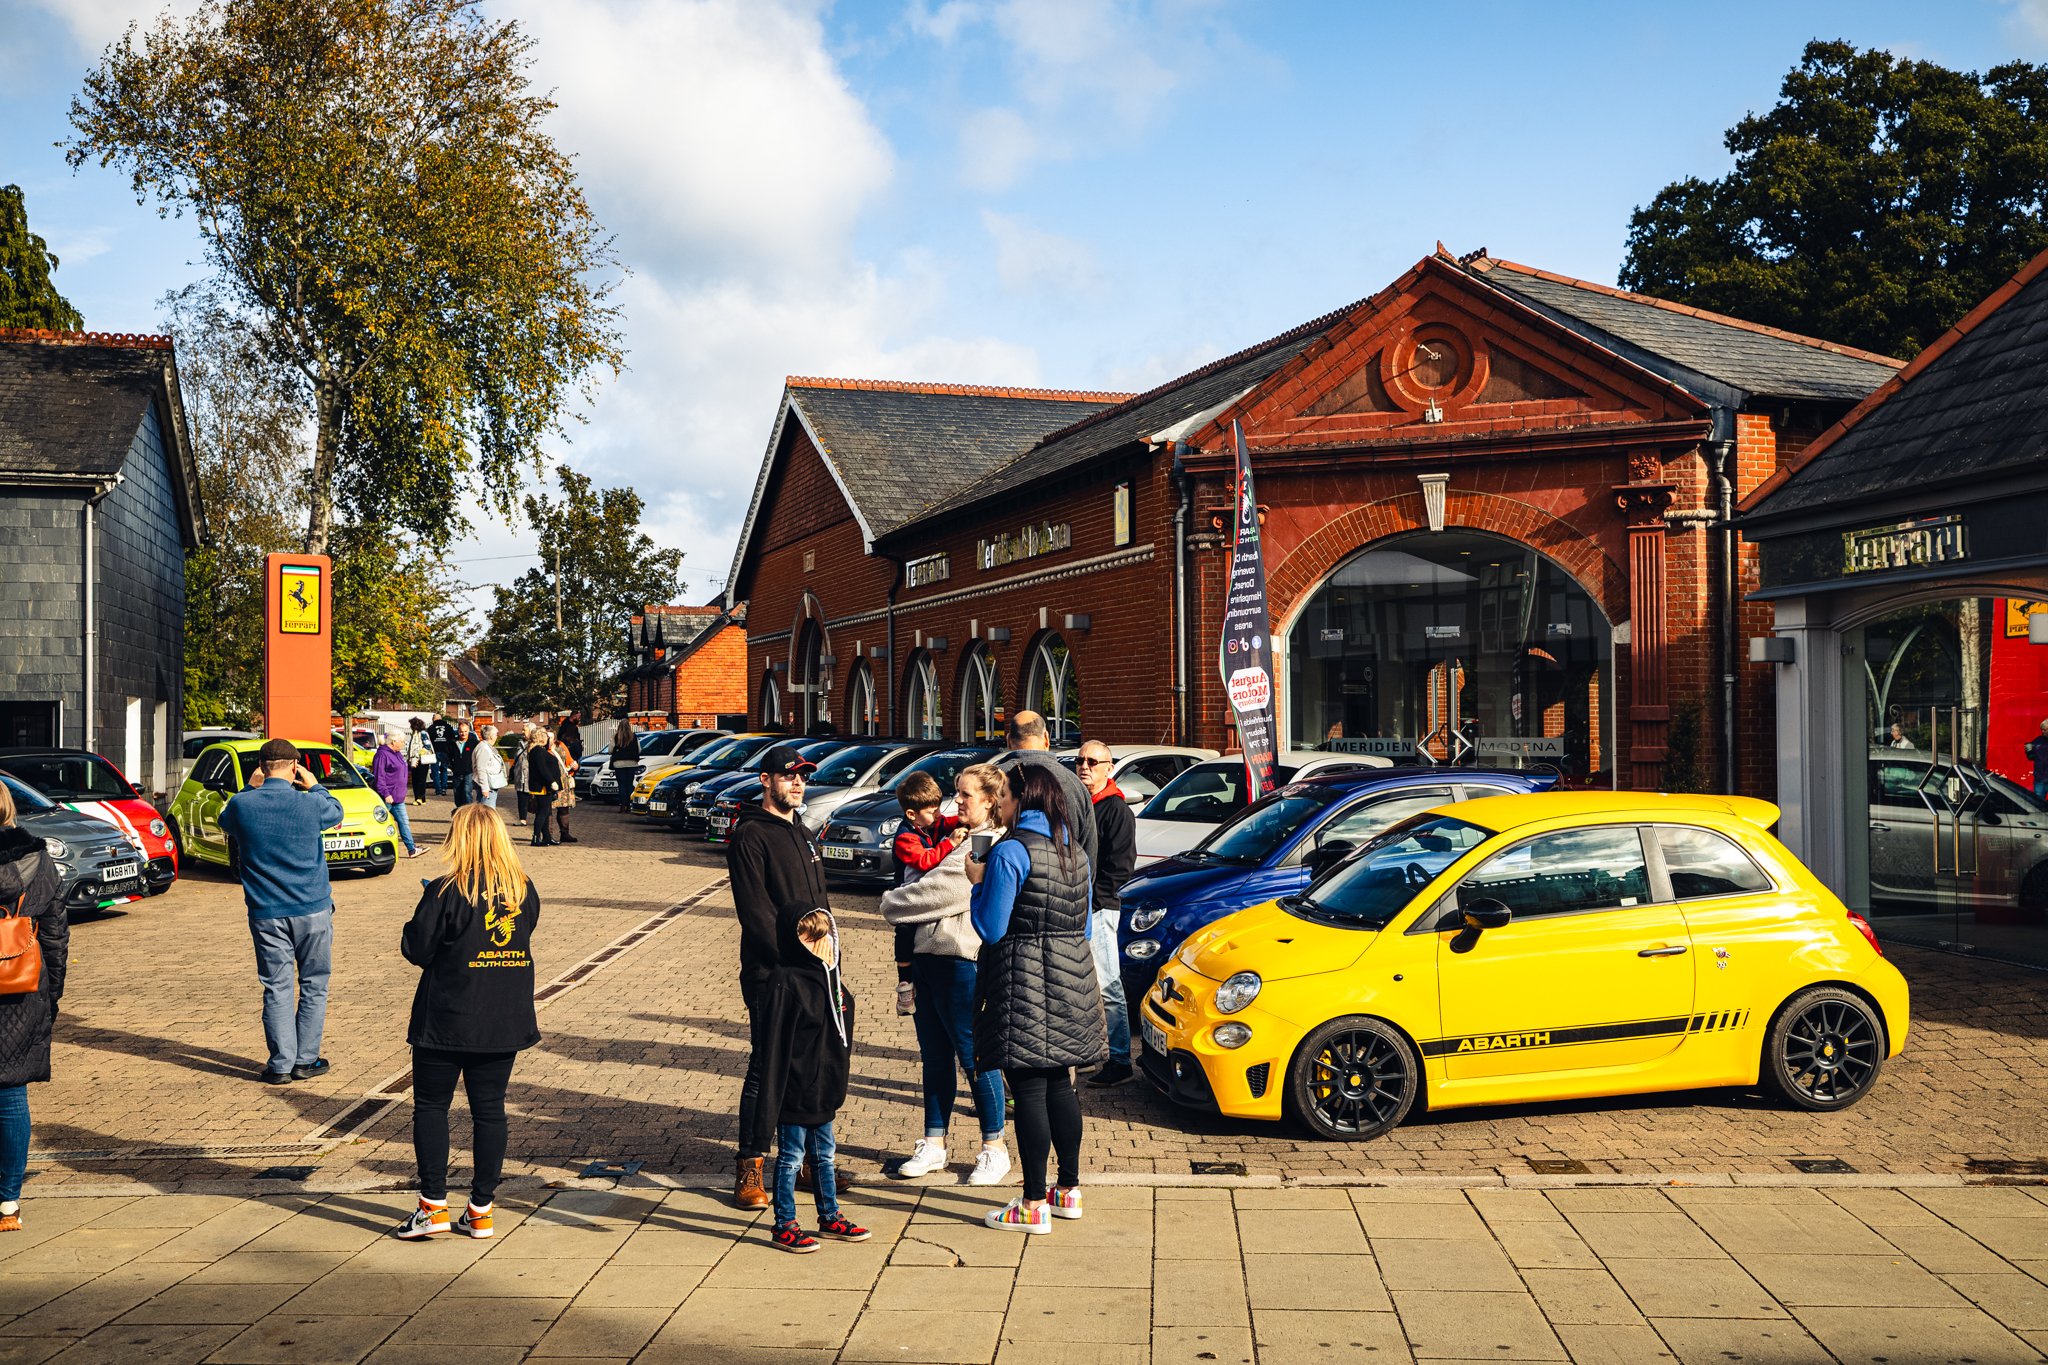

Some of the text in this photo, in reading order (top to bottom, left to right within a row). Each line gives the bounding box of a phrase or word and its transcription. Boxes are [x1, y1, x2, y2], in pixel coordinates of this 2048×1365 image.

[1843, 514, 1965, 574] Ferrari
[284, 620, 316, 630] Ferrari
[1335, 741, 1557, 752] MERIDIEN MODENA
[344, 839, 362, 848] ABY
[123, 863, 136, 876] HTK
[97, 881, 138, 896] ABARTH
[477, 950, 525, 959] ABARTH
[1457, 1031, 1550, 1052] ABARTH
